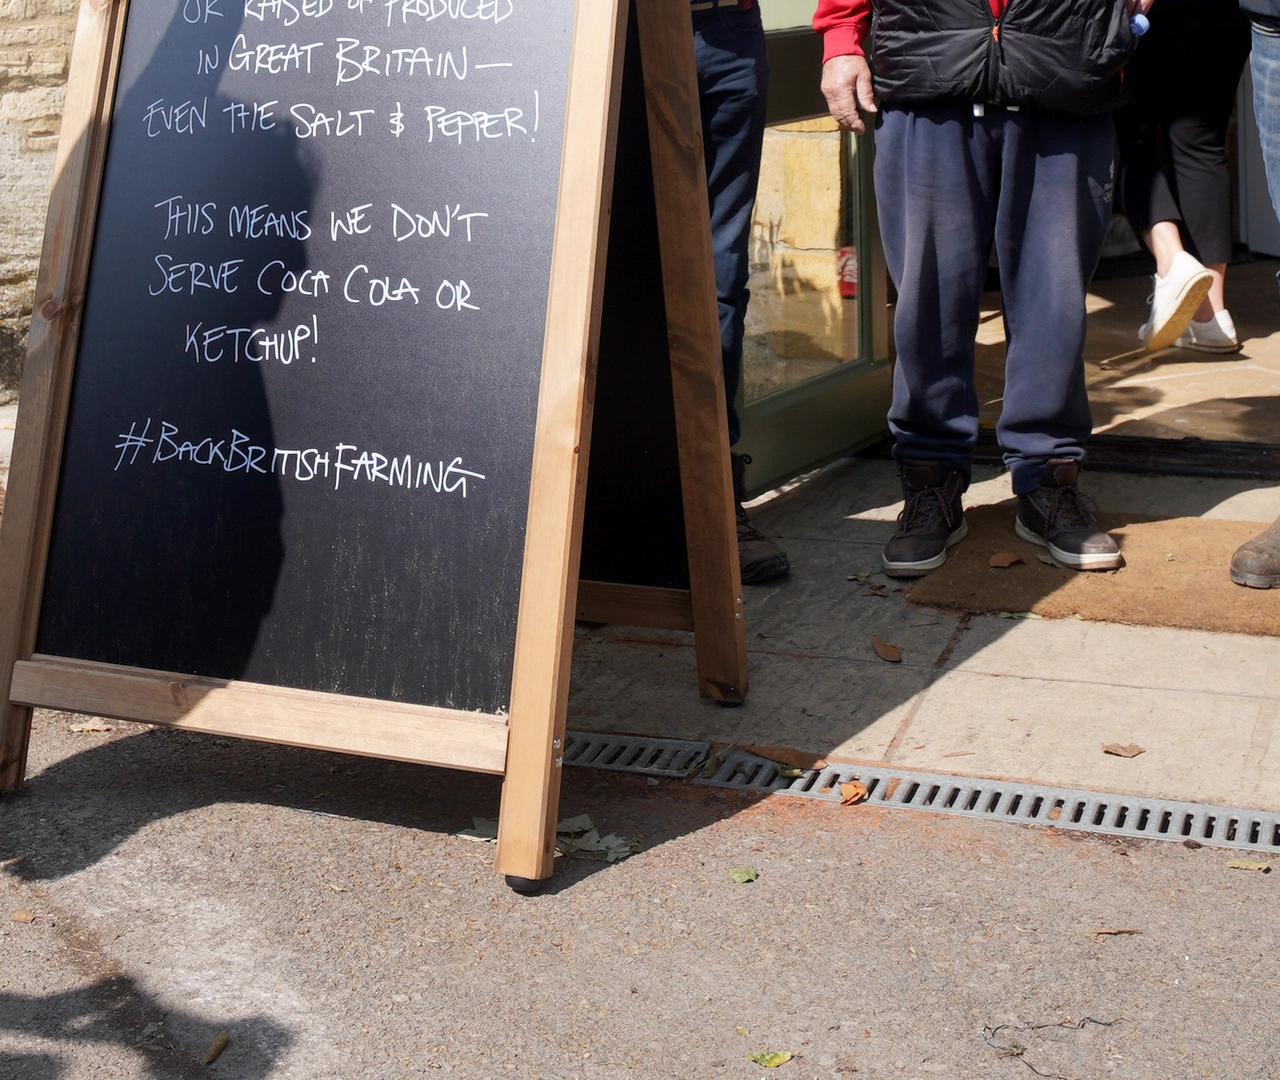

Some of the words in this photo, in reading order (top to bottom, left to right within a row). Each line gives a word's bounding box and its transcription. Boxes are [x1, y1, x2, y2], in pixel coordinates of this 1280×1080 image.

[196, 44, 219, 75] IN
[228, 33, 324, 75] GREAT
[142, 96, 208, 138] EVEN
[222, 99, 279, 134] THE
[289, 102, 376, 139] SALT
[423, 89, 540, 145] PEPPER!
[153, 194, 217, 240] THIS
[228, 203, 312, 241] MEANS
[330, 202, 374, 242] WE
[390, 202, 489, 243] DON'T
[148, 253, 245, 297] SERVE
[256, 259, 331, 298] COCA
[343, 263, 421, 307] COLA
[435, 279, 481, 312] OR
[184, 313, 319, 365] KETCHUP!
[113, 417, 486, 499] #BACKBRITISHFARMING
